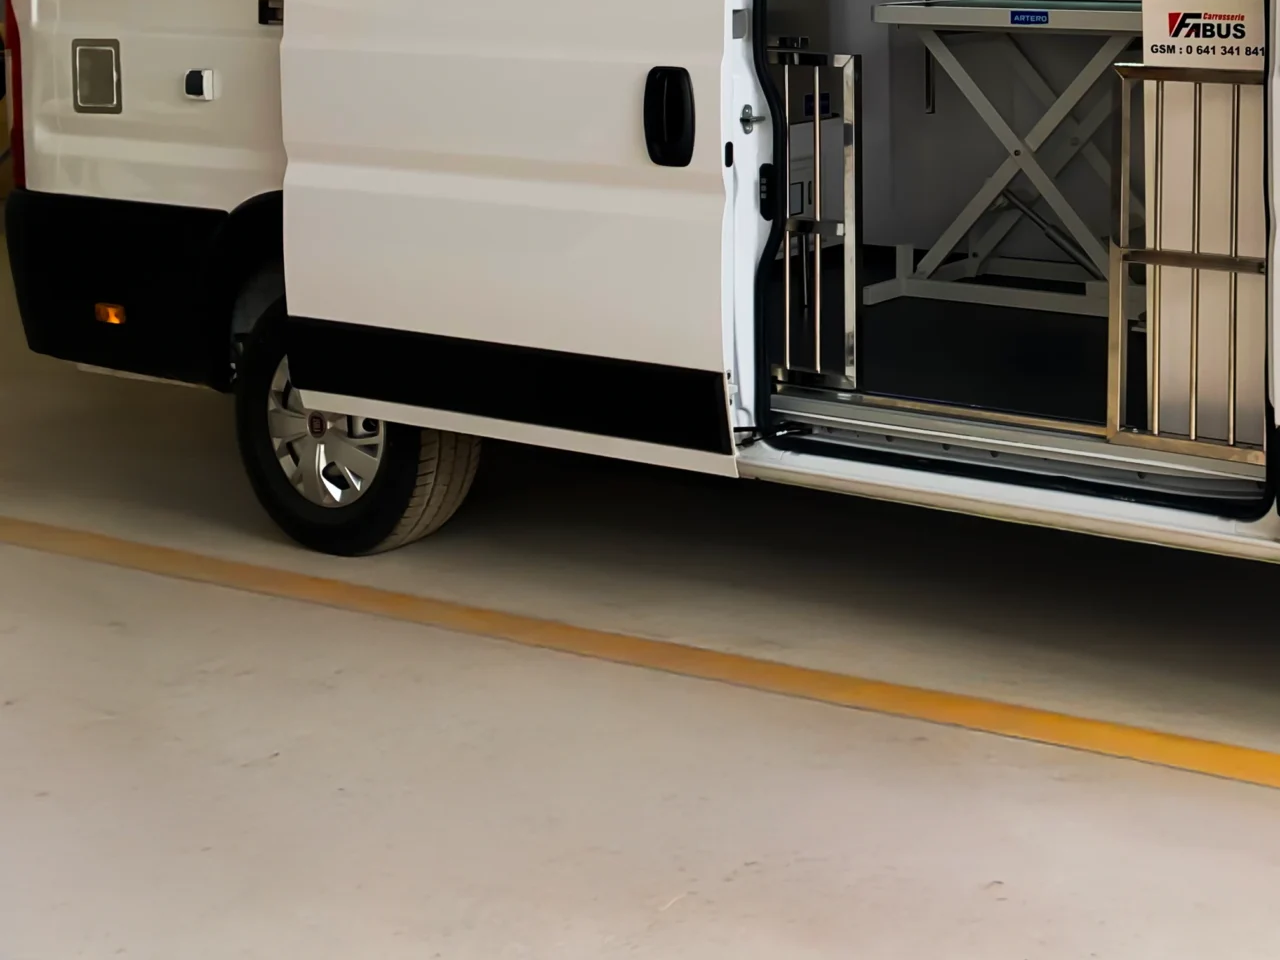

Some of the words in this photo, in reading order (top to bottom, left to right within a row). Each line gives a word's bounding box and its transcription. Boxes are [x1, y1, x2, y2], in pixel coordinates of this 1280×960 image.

[1013, 14, 1048, 22] ARTERO
[1170, 12, 1246, 39] FABUS
[1150, 44, 1176, 54] GSM
[1186, 45, 1193, 54] 0
[1196, 45, 1216, 55] 641
[1220, 46, 1240, 56] 341
[1245, 46, 1265, 56] 841
